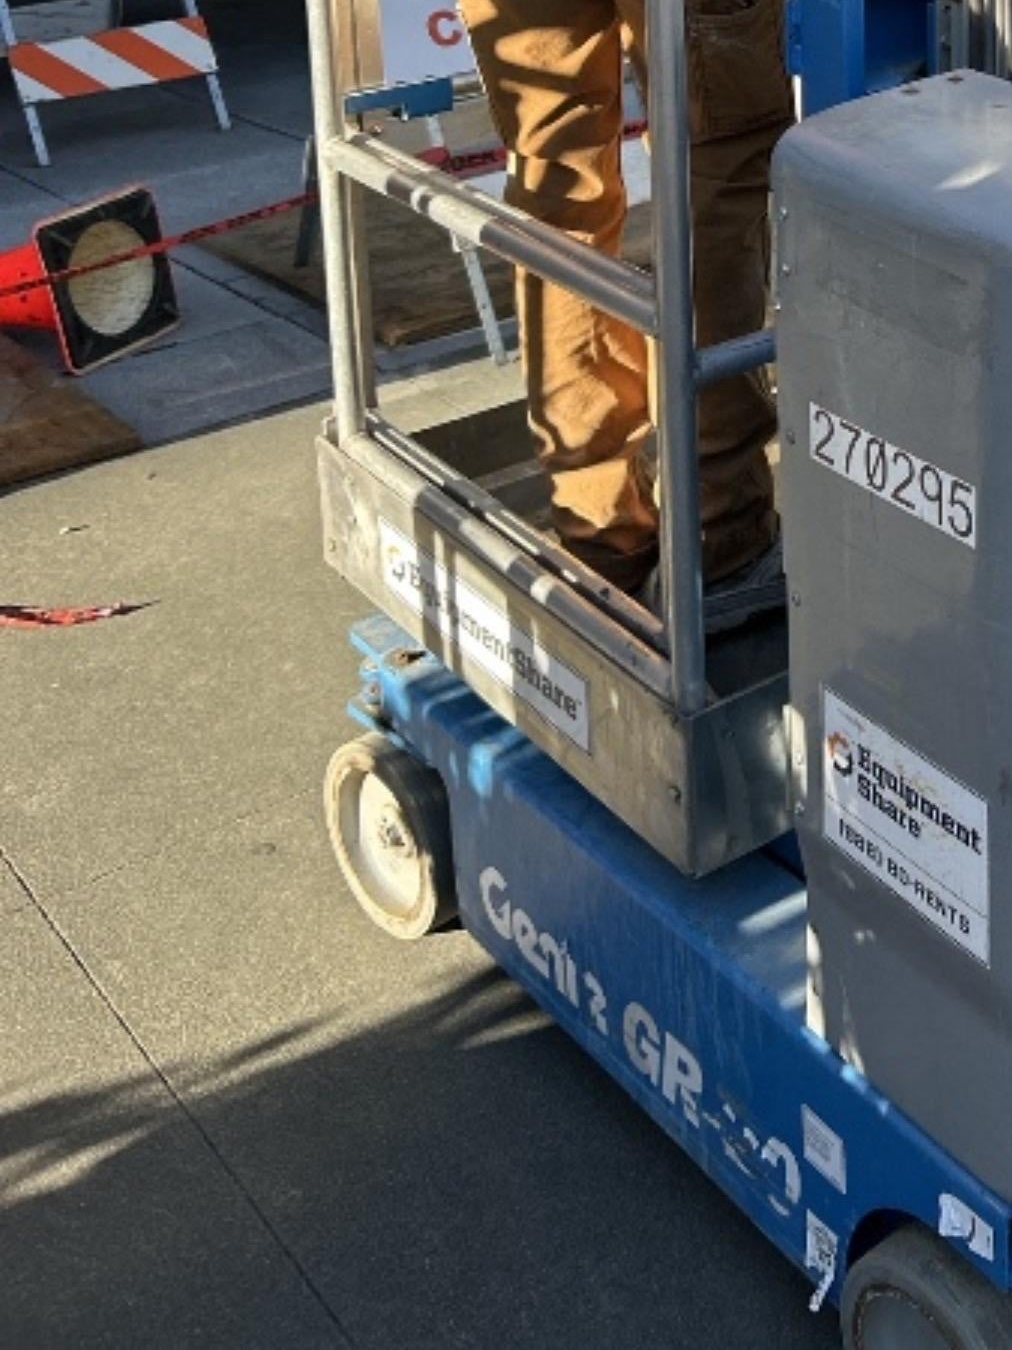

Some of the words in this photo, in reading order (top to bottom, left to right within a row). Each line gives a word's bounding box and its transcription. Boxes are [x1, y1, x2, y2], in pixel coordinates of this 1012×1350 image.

[814, 410, 973, 538] 270295
[857, 742, 982, 856] Equipment
[857, 773, 921, 839] Share
